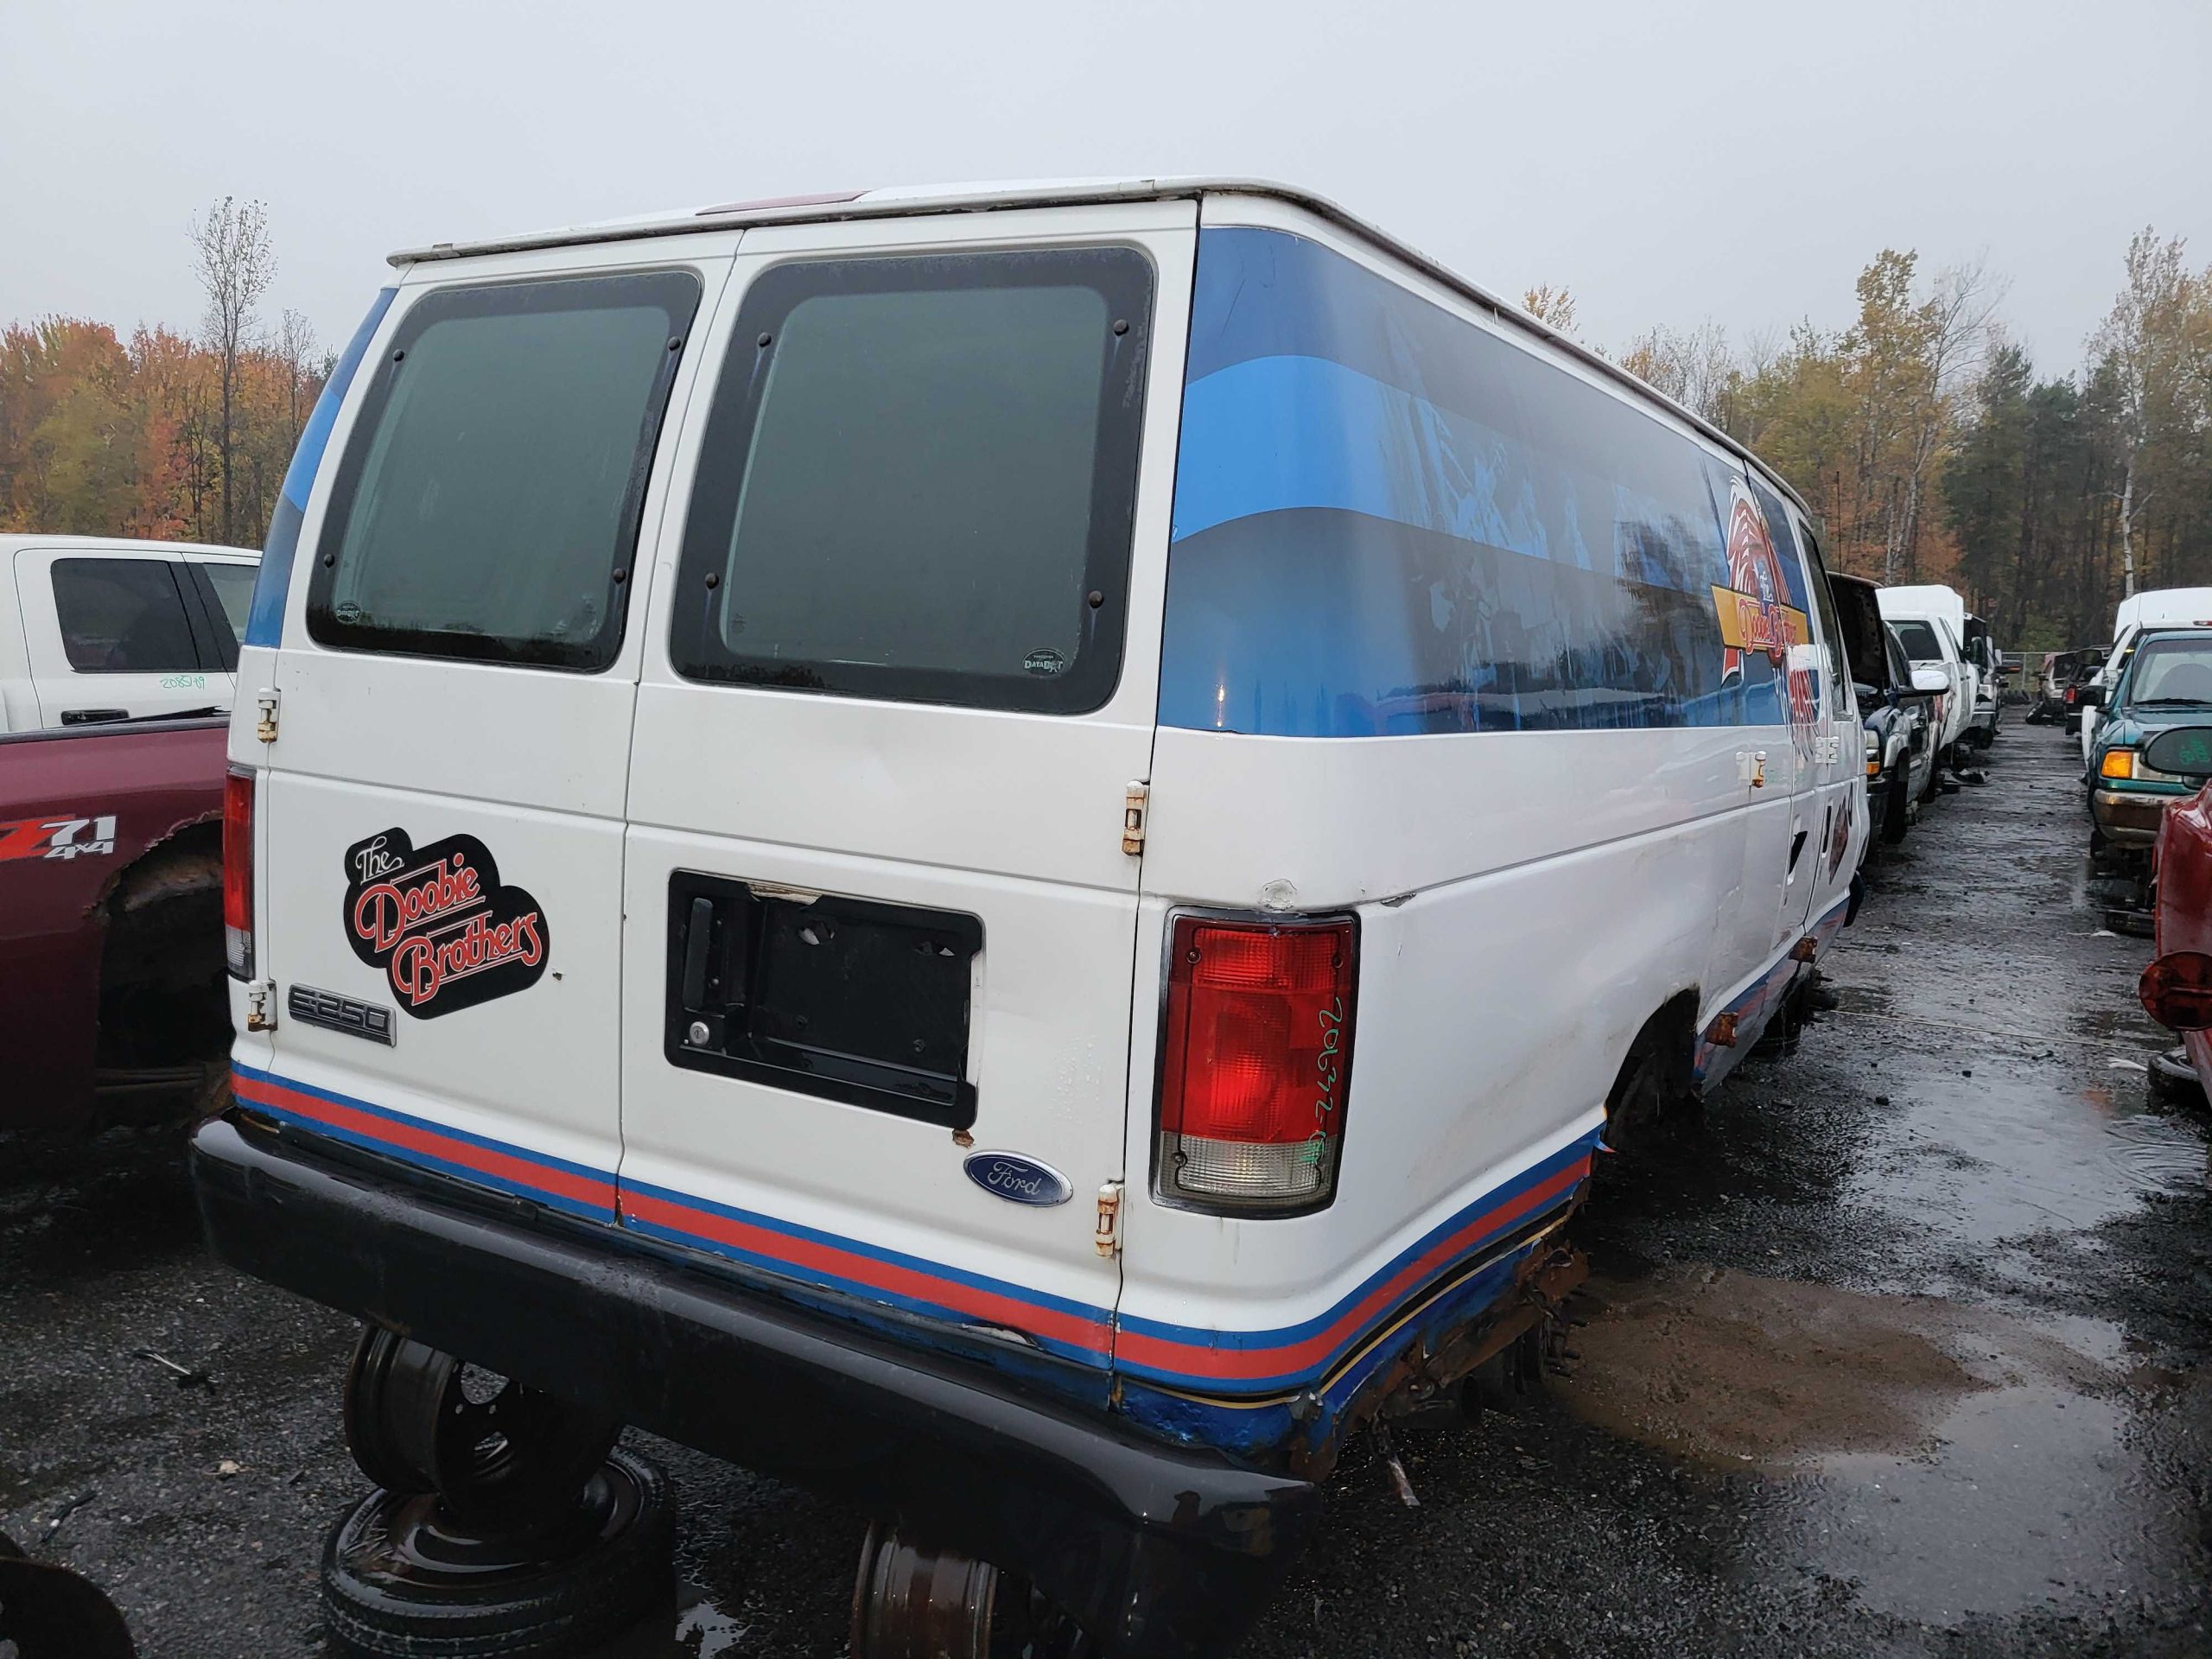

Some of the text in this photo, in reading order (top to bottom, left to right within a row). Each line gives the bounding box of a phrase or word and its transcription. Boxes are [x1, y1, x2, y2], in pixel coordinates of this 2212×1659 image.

[354, 836, 404, 886] The
[354, 853, 486, 953] Doobie
[392, 910, 543, 1006] Brothers
[987, 1161, 1042, 1196] Ford
